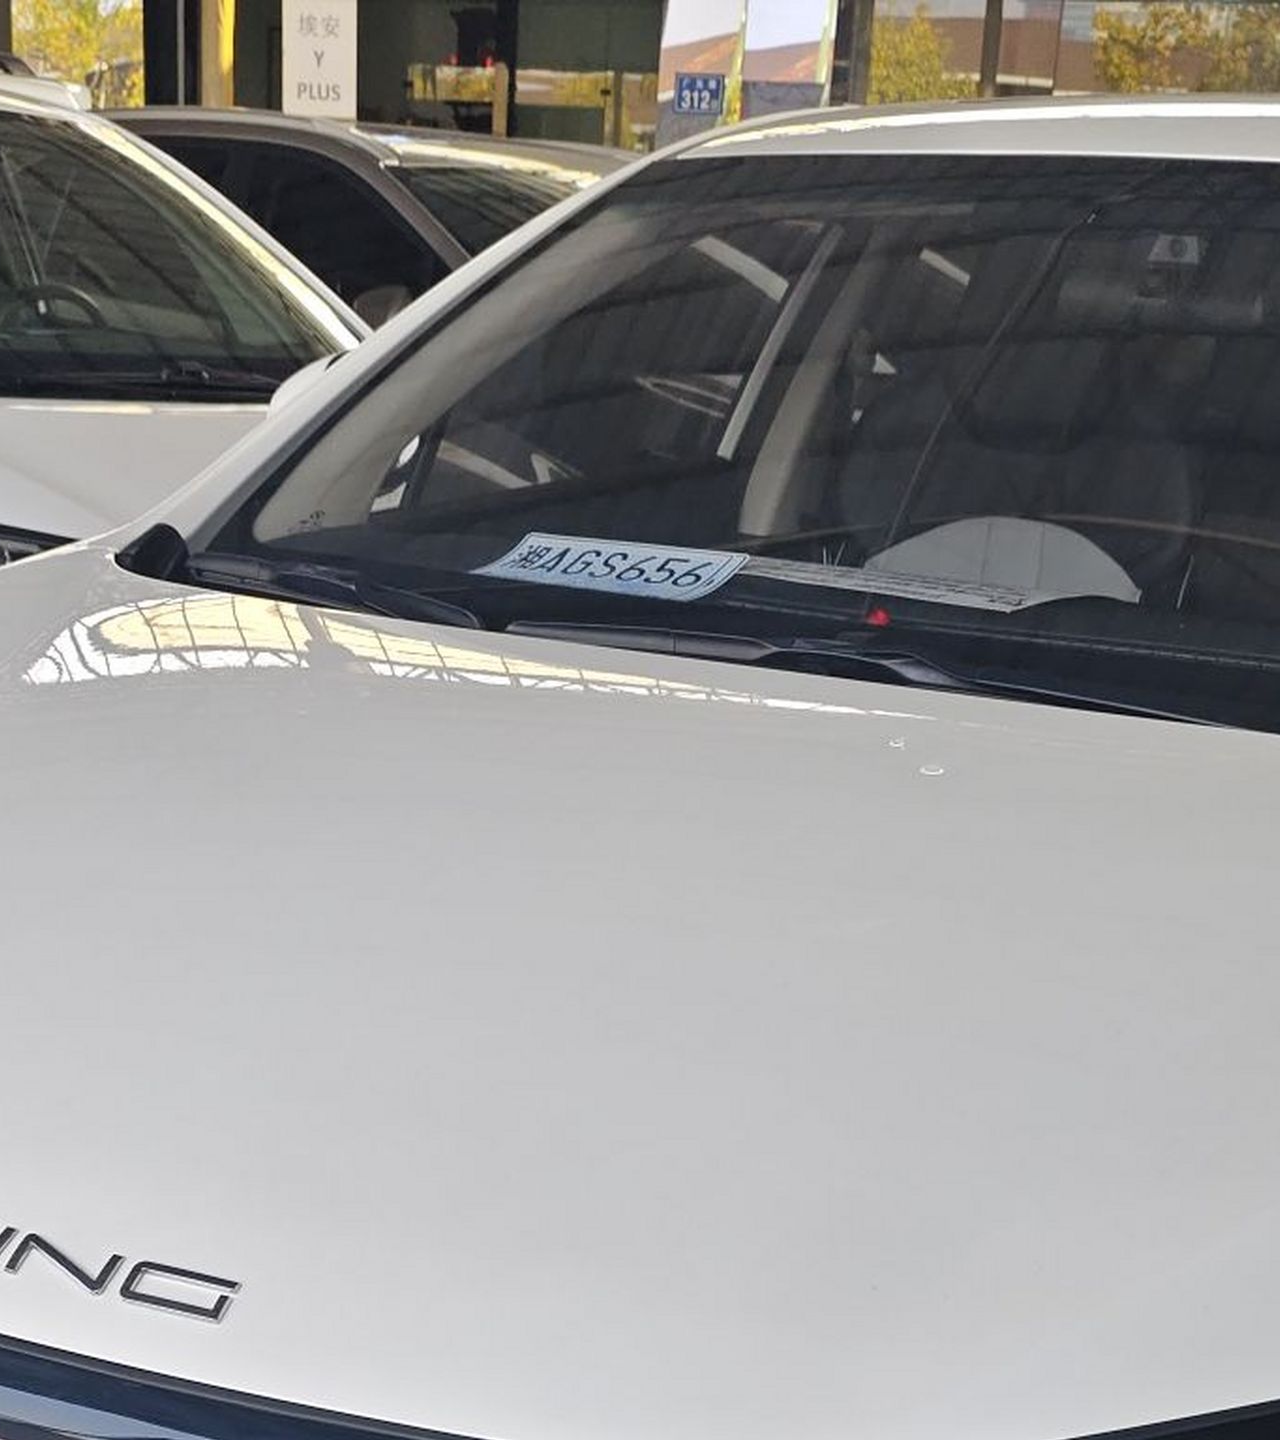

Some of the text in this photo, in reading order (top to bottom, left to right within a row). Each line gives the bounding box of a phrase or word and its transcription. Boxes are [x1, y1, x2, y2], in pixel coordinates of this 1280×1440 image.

[297, 13, 340, 38] 埃安
[313, 50, 325, 68] Y
[297, 82, 341, 101] PLUS
[508, 544, 713, 587] 湘AGS656
